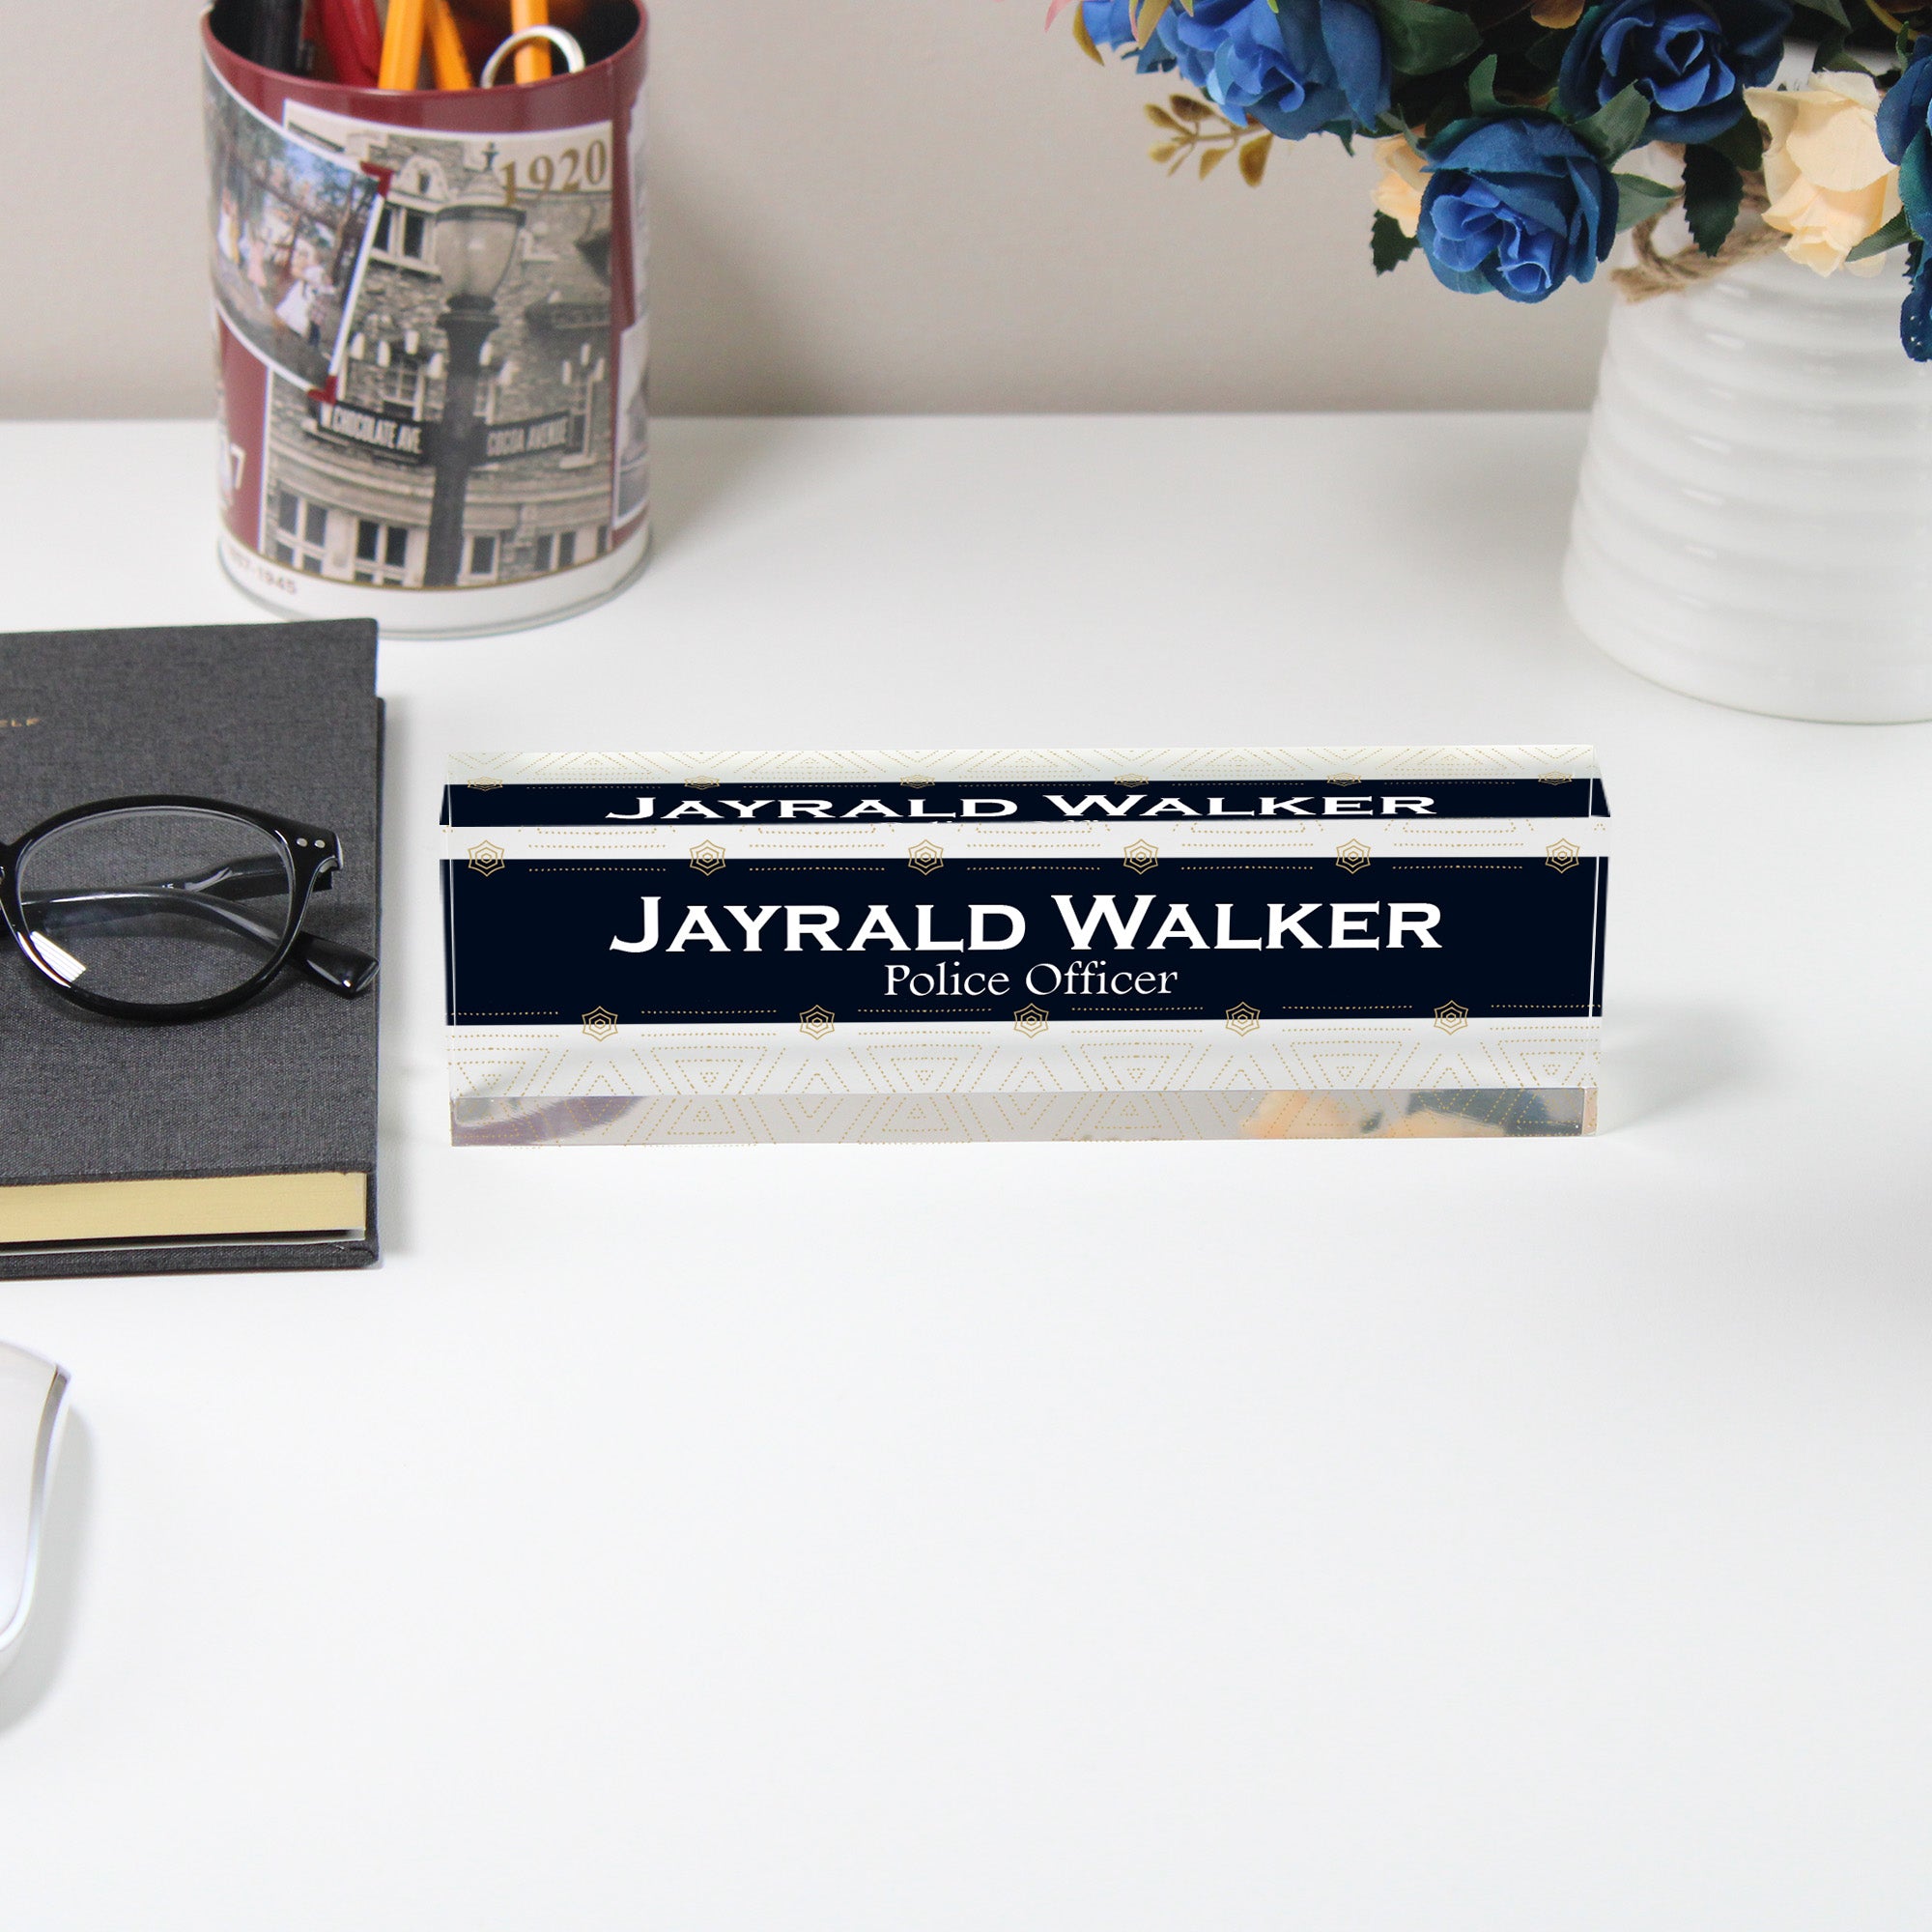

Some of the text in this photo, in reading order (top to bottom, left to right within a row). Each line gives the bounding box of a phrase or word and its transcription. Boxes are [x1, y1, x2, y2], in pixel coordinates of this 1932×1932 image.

[500, 139, 607, 207] 1920
[332, 406, 397, 450] CHOCOLATE
[396, 424, 422, 455] AVE
[487, 416, 569, 457] COCOA AVENUE
[609, 894, 1443, 953] JAYRALD WALKER
[884, 959, 1179, 996] Police Officer
